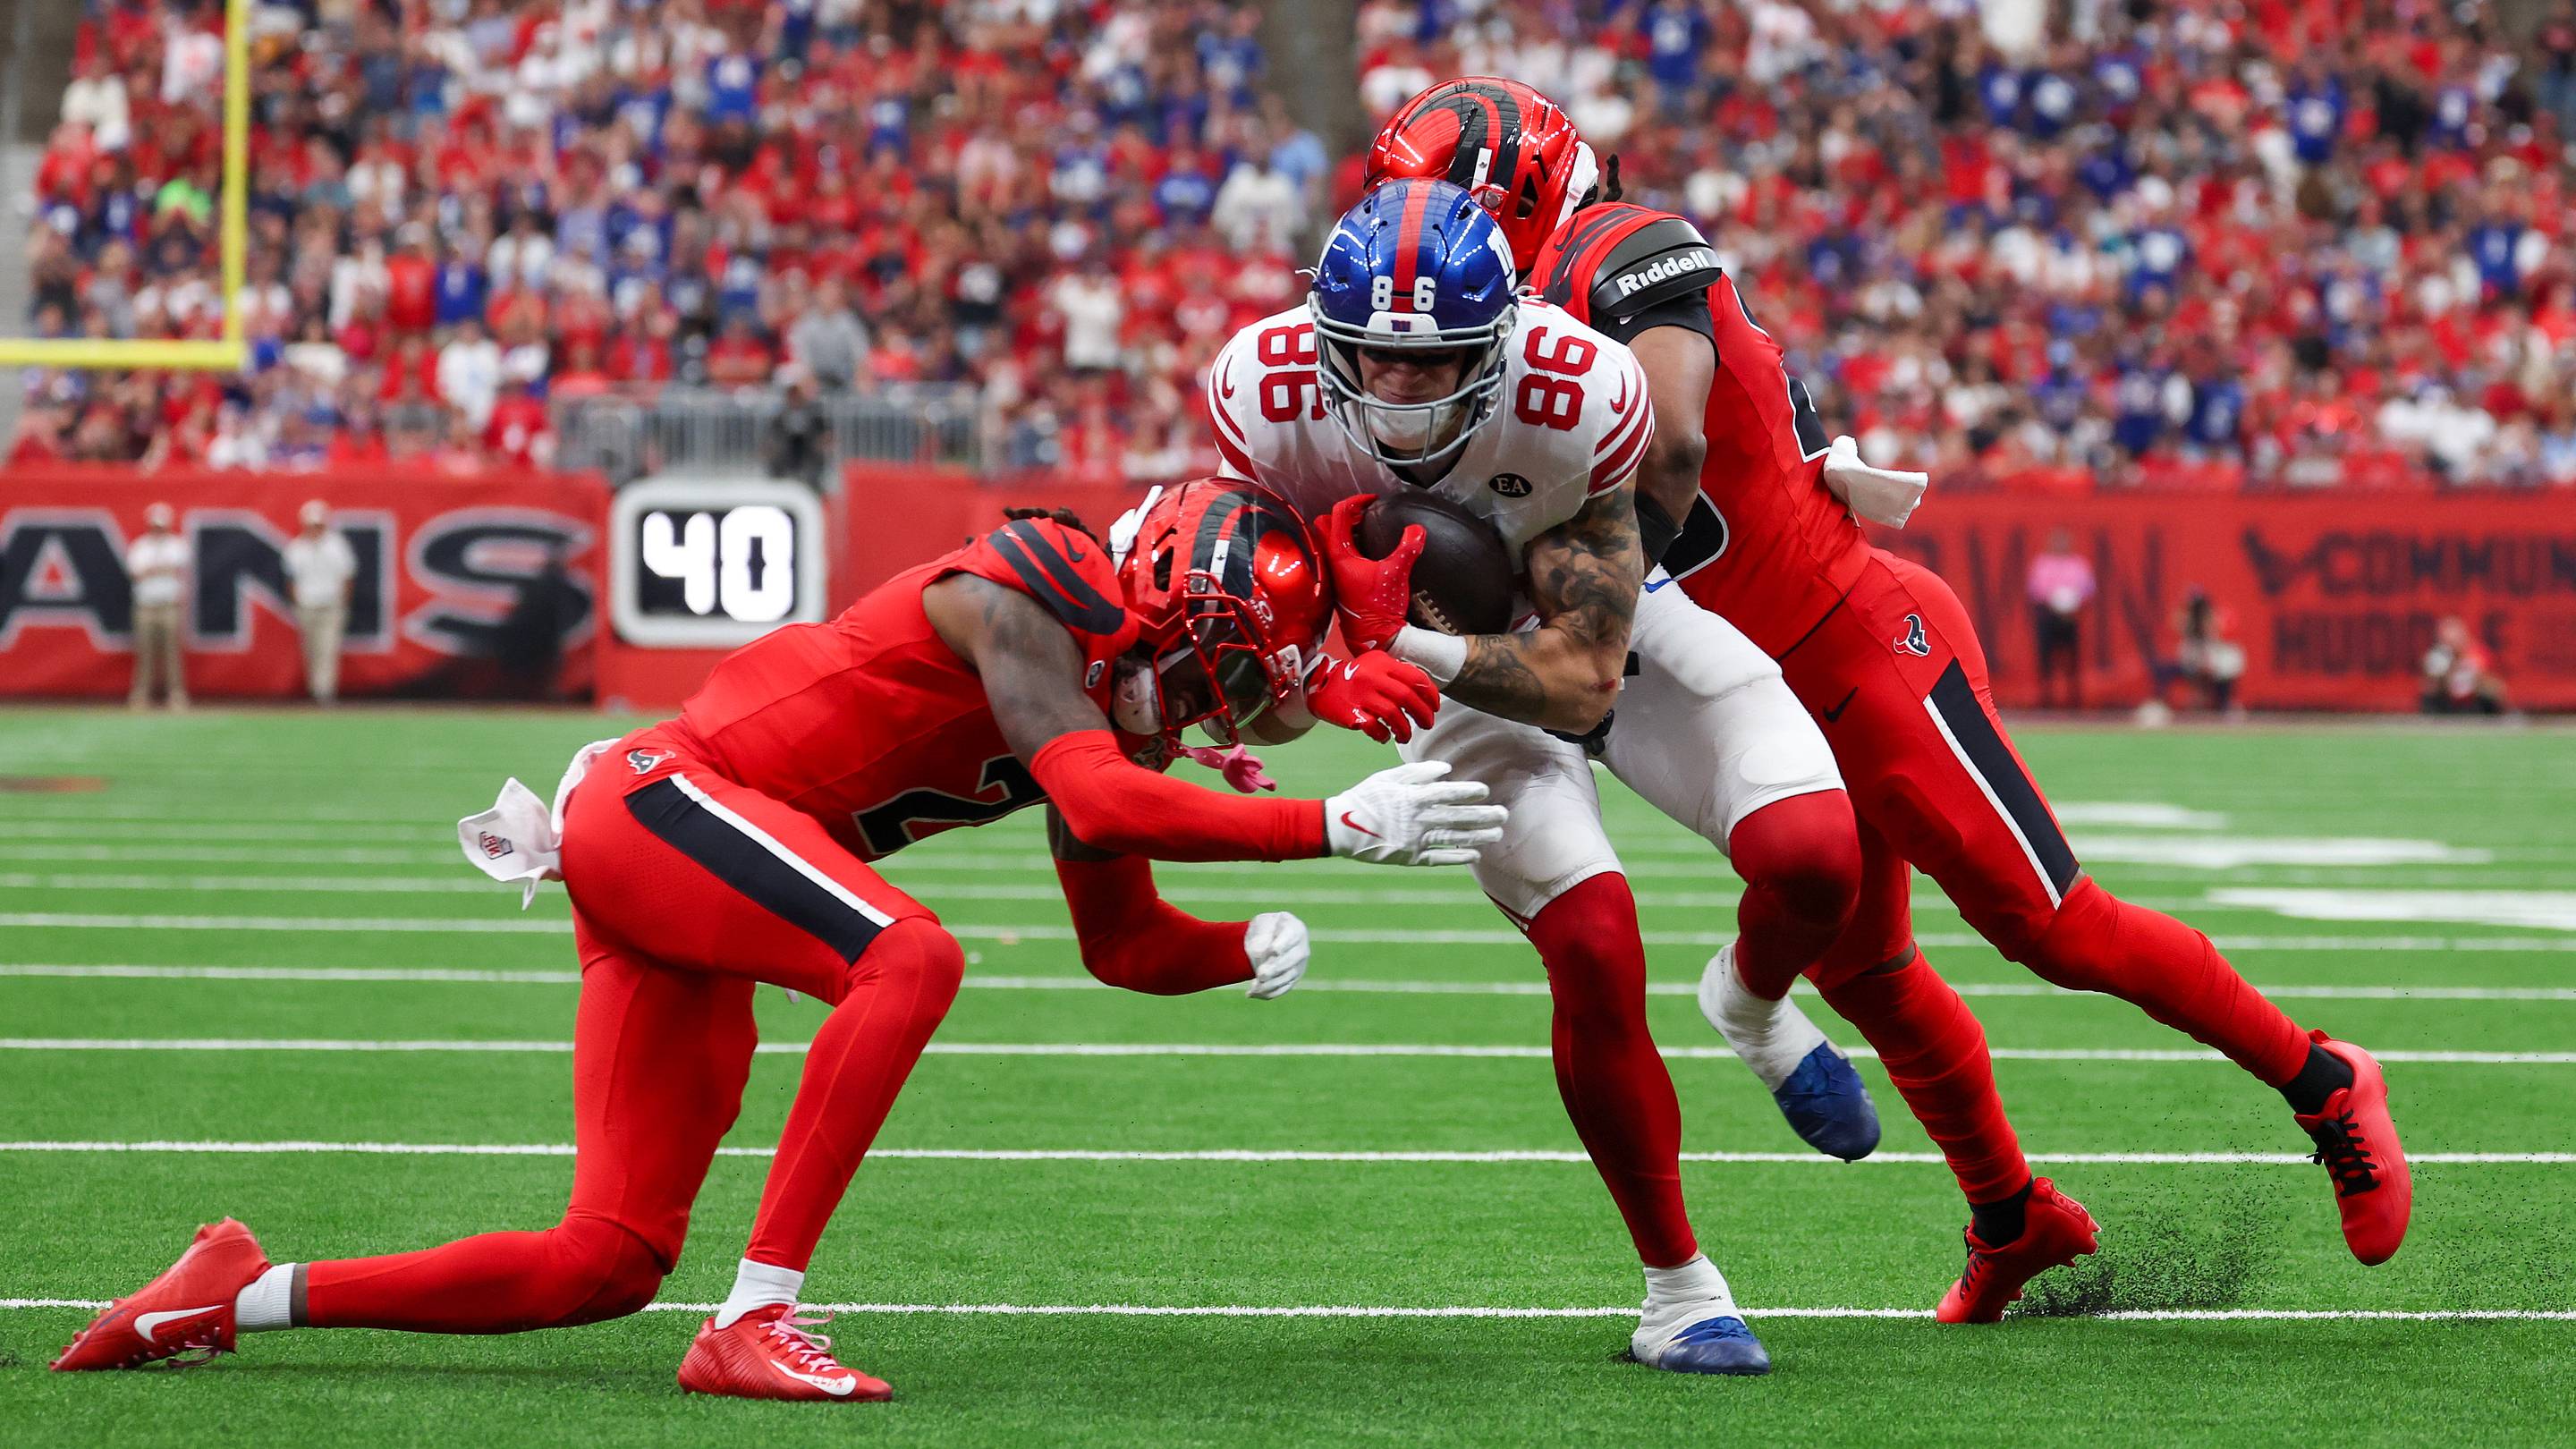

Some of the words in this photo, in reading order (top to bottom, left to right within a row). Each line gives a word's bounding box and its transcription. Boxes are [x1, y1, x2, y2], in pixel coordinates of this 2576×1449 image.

[1616, 250, 1710, 296] Riddell
[1258, 323, 1327, 423] 86
[1514, 326, 1598, 432] 86
[1496, 477, 1526, 494] EA
[642, 505, 793, 623] 40
